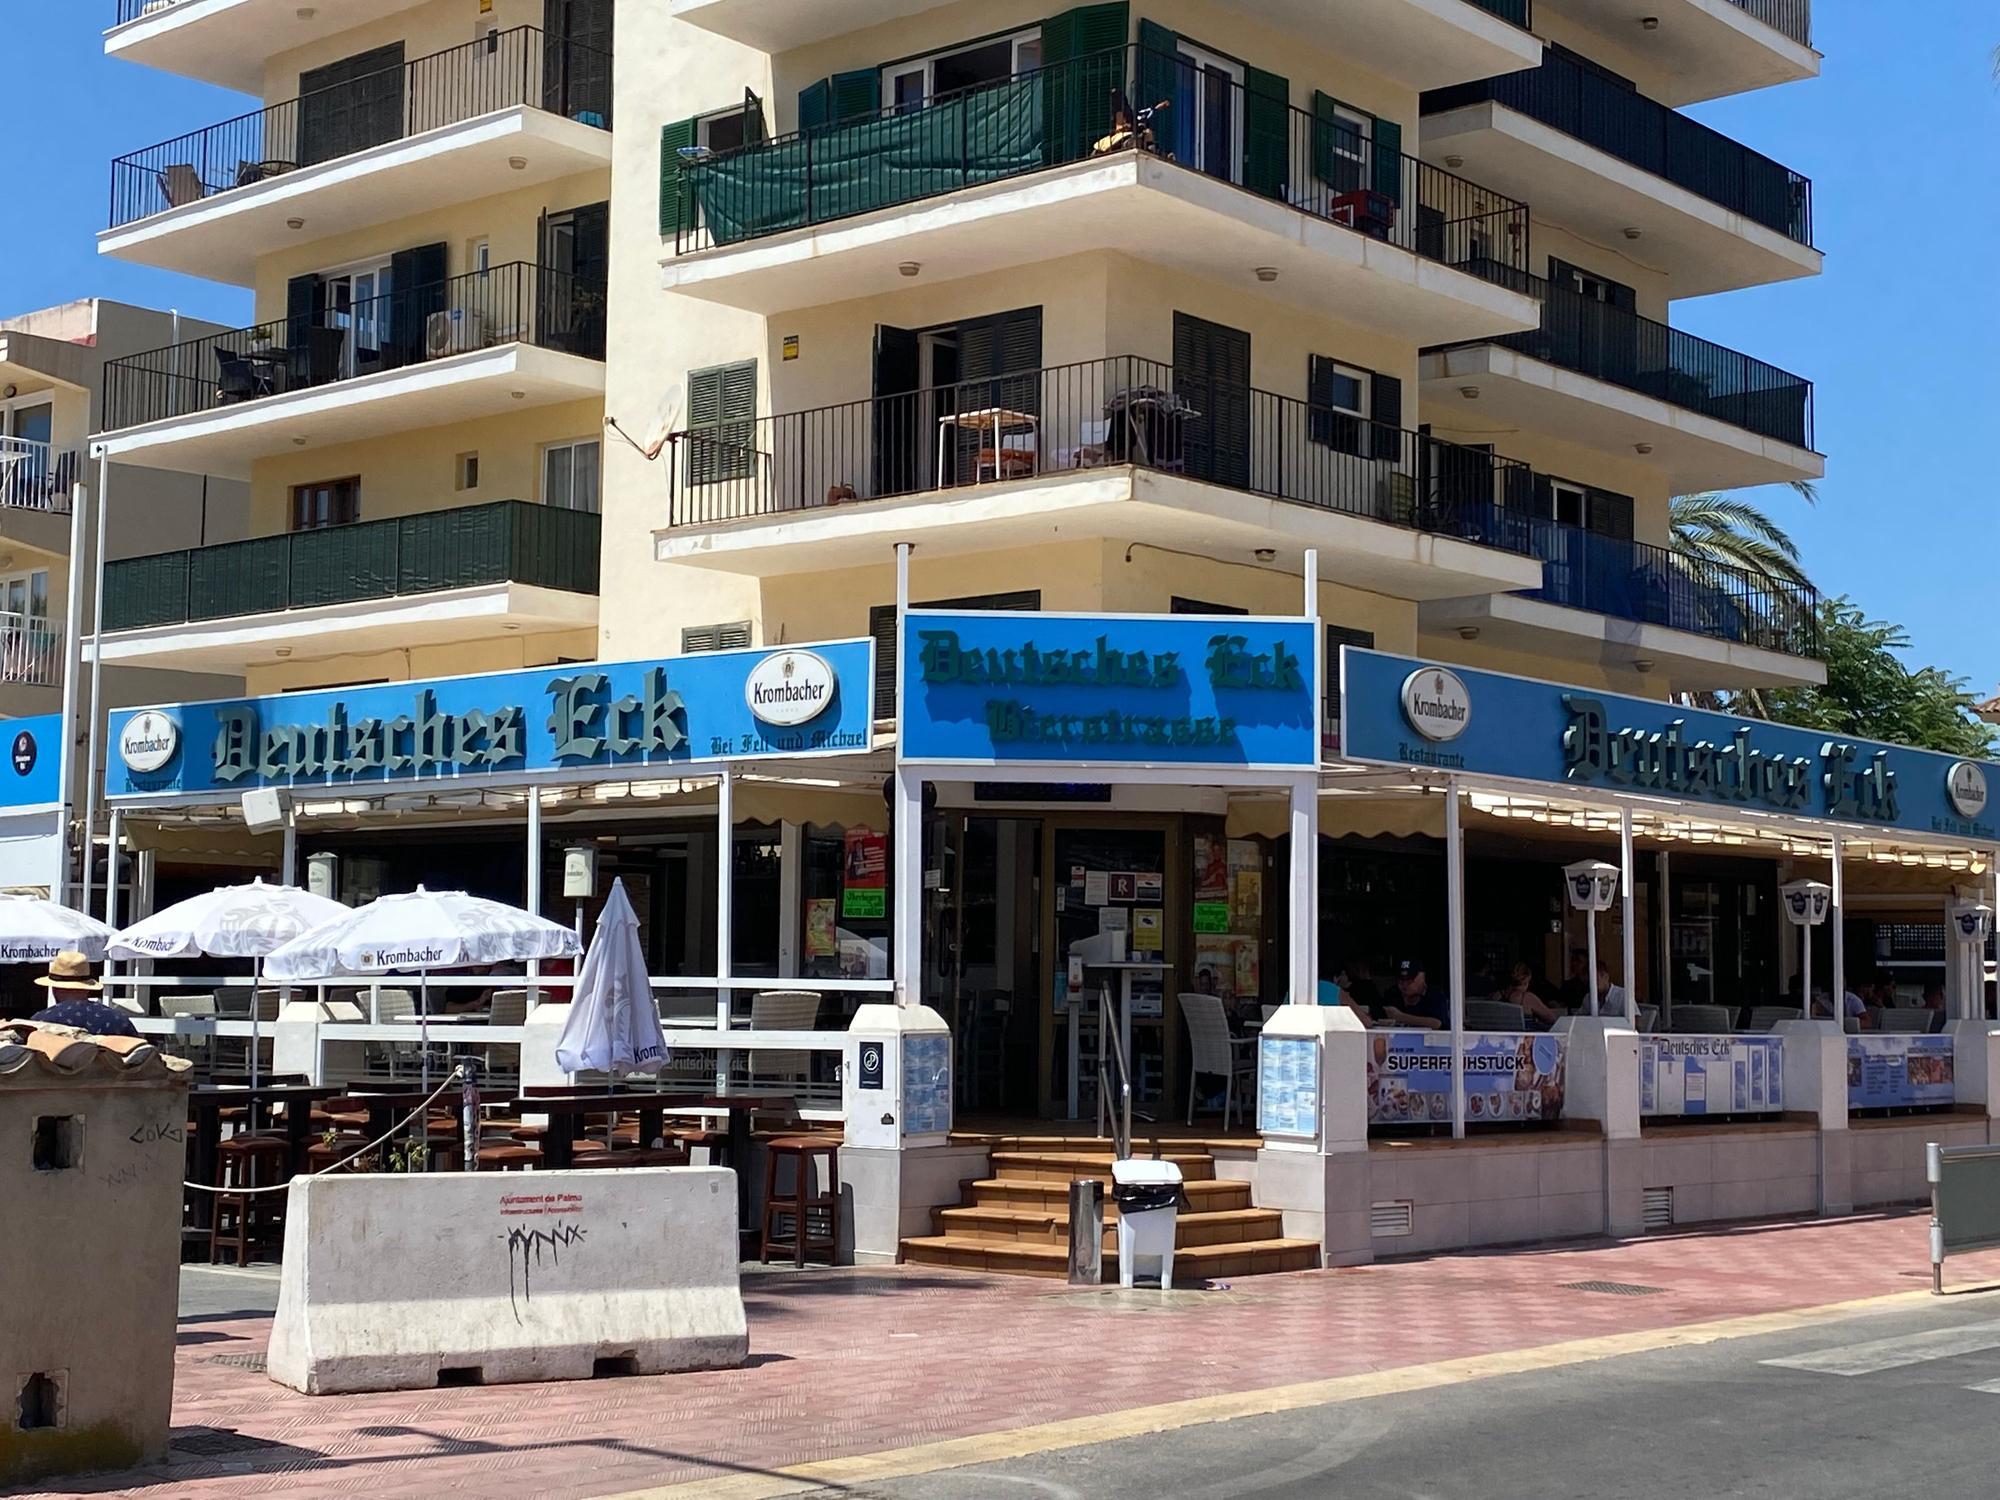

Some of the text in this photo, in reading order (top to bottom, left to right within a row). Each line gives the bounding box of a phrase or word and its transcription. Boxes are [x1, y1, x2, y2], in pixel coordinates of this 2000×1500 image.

[918, 630, 1300, 690] Deutsches Eck
[753, 680, 825, 705] Krombacher
[1413, 693, 1466, 722] Krombacher
[213, 666, 688, 782] Deutsches Eck
[986, 699, 1237, 746] Bierstrasse
[125, 734, 170, 755] Krombacher
[710, 736, 733, 755] Bei
[777, 732, 803, 751] und
[811, 727, 867, 749] Michael
[1398, 742, 1465, 768] Restaurante
[1561, 693, 1899, 821] Deutsches Eck
[1, 946, 60, 958] Krombacher
[377, 946, 443, 966] Krombacher
[1661, 1038, 1730, 1057] Deutsches Eck
[1388, 1053, 1525, 1071] SUPERFHSTÜCK
[499, 1193, 583, 1206] Ajuntament de Palma
